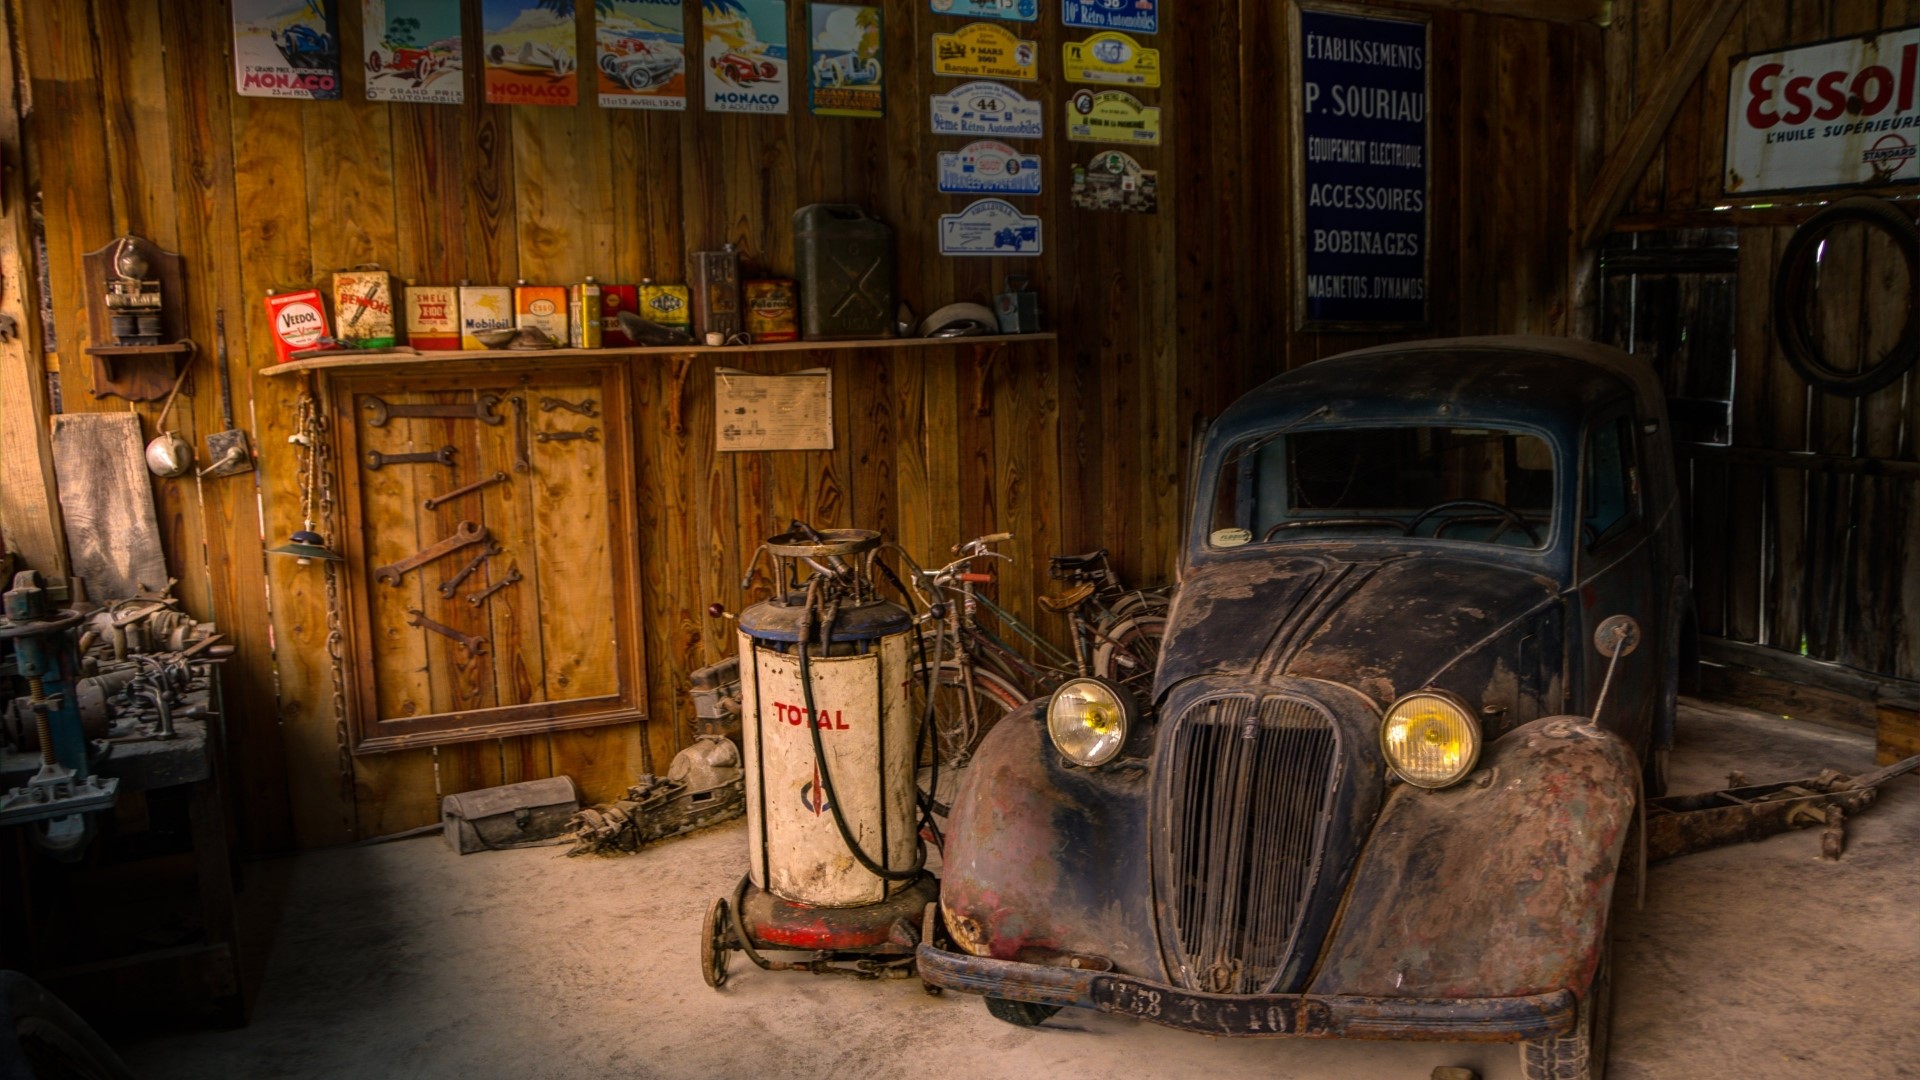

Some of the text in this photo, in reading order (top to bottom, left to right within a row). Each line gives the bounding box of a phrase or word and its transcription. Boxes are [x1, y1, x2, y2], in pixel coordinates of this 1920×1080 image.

[1306, 31, 1423, 71] ÉTABLISSEMENTS
[944, 63, 979, 74] Banque
[244, 73, 336, 91] MONACO
[389, 87, 428, 96] GRAND
[492, 82, 571, 98] MONACO
[715, 93, 779, 105] MONACO
[977, 98, 997, 110] 44
[961, 119, 985, 133] Rétro
[1766, 116, 1920, 144] L'HUILE SUPÉRIEURE
[1863, 148, 1917, 161] STANDARD
[1309, 183, 1424, 213] ACCESSOIRES
[1313, 229, 1419, 256] BOBINAGES
[416, 294, 447, 302] SHELL
[422, 306, 443, 317] X-100
[282, 312, 317, 328] VEEDOL
[466, 319, 509, 329] Mobiloil
